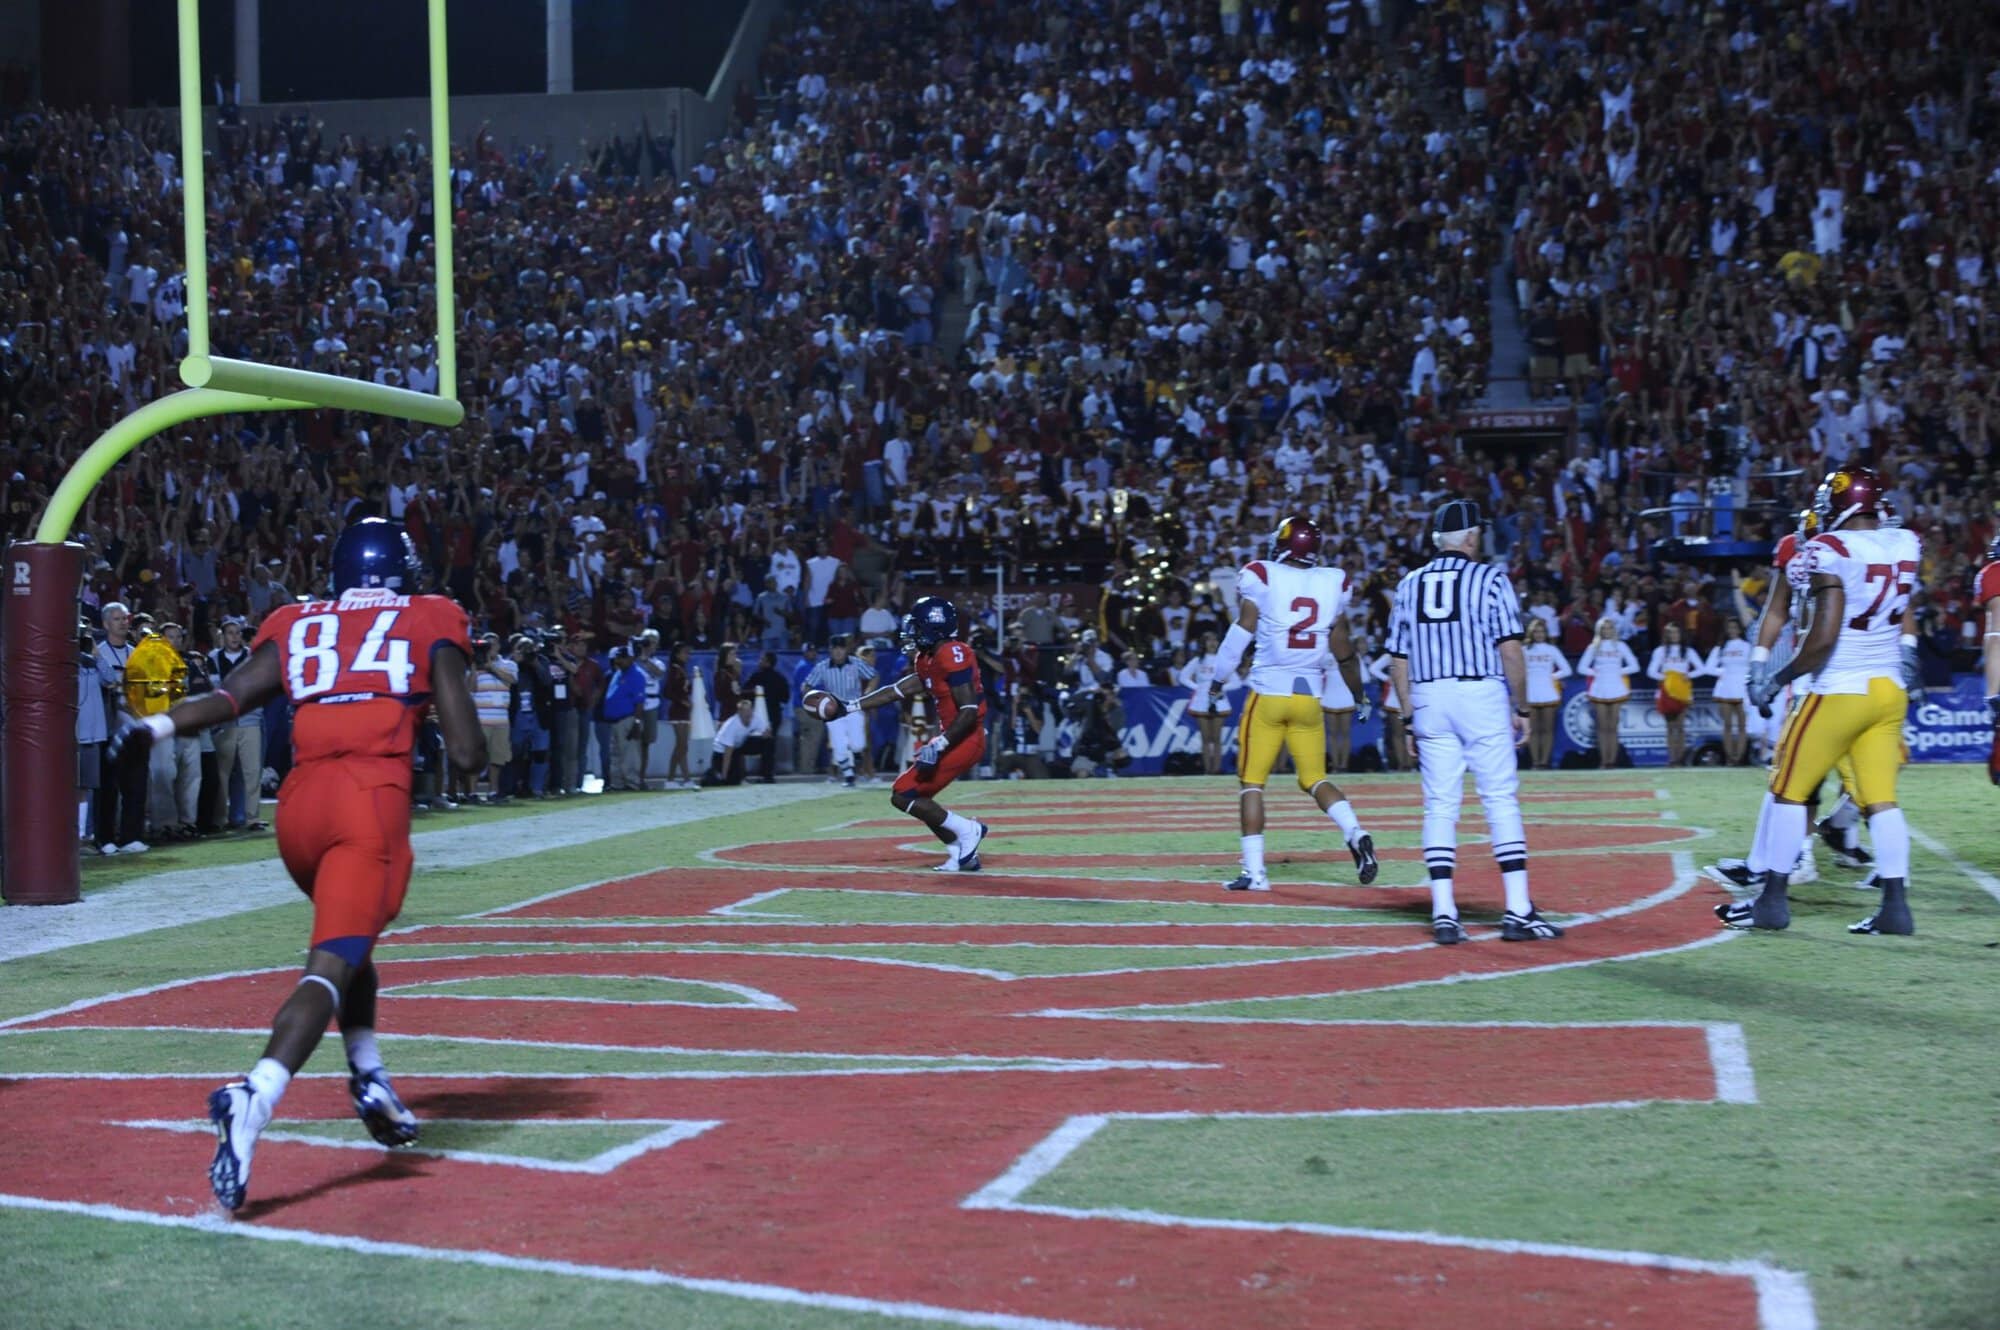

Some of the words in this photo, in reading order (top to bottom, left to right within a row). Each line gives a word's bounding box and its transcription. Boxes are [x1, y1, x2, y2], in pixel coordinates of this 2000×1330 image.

[14, 561, 32, 584] R
[1421, 571, 1459, 619] U
[1286, 596, 1320, 649] 2
[287, 609, 416, 700] 84
[951, 645, 964, 664] 5
[1902, 725, 1995, 752] Spons
